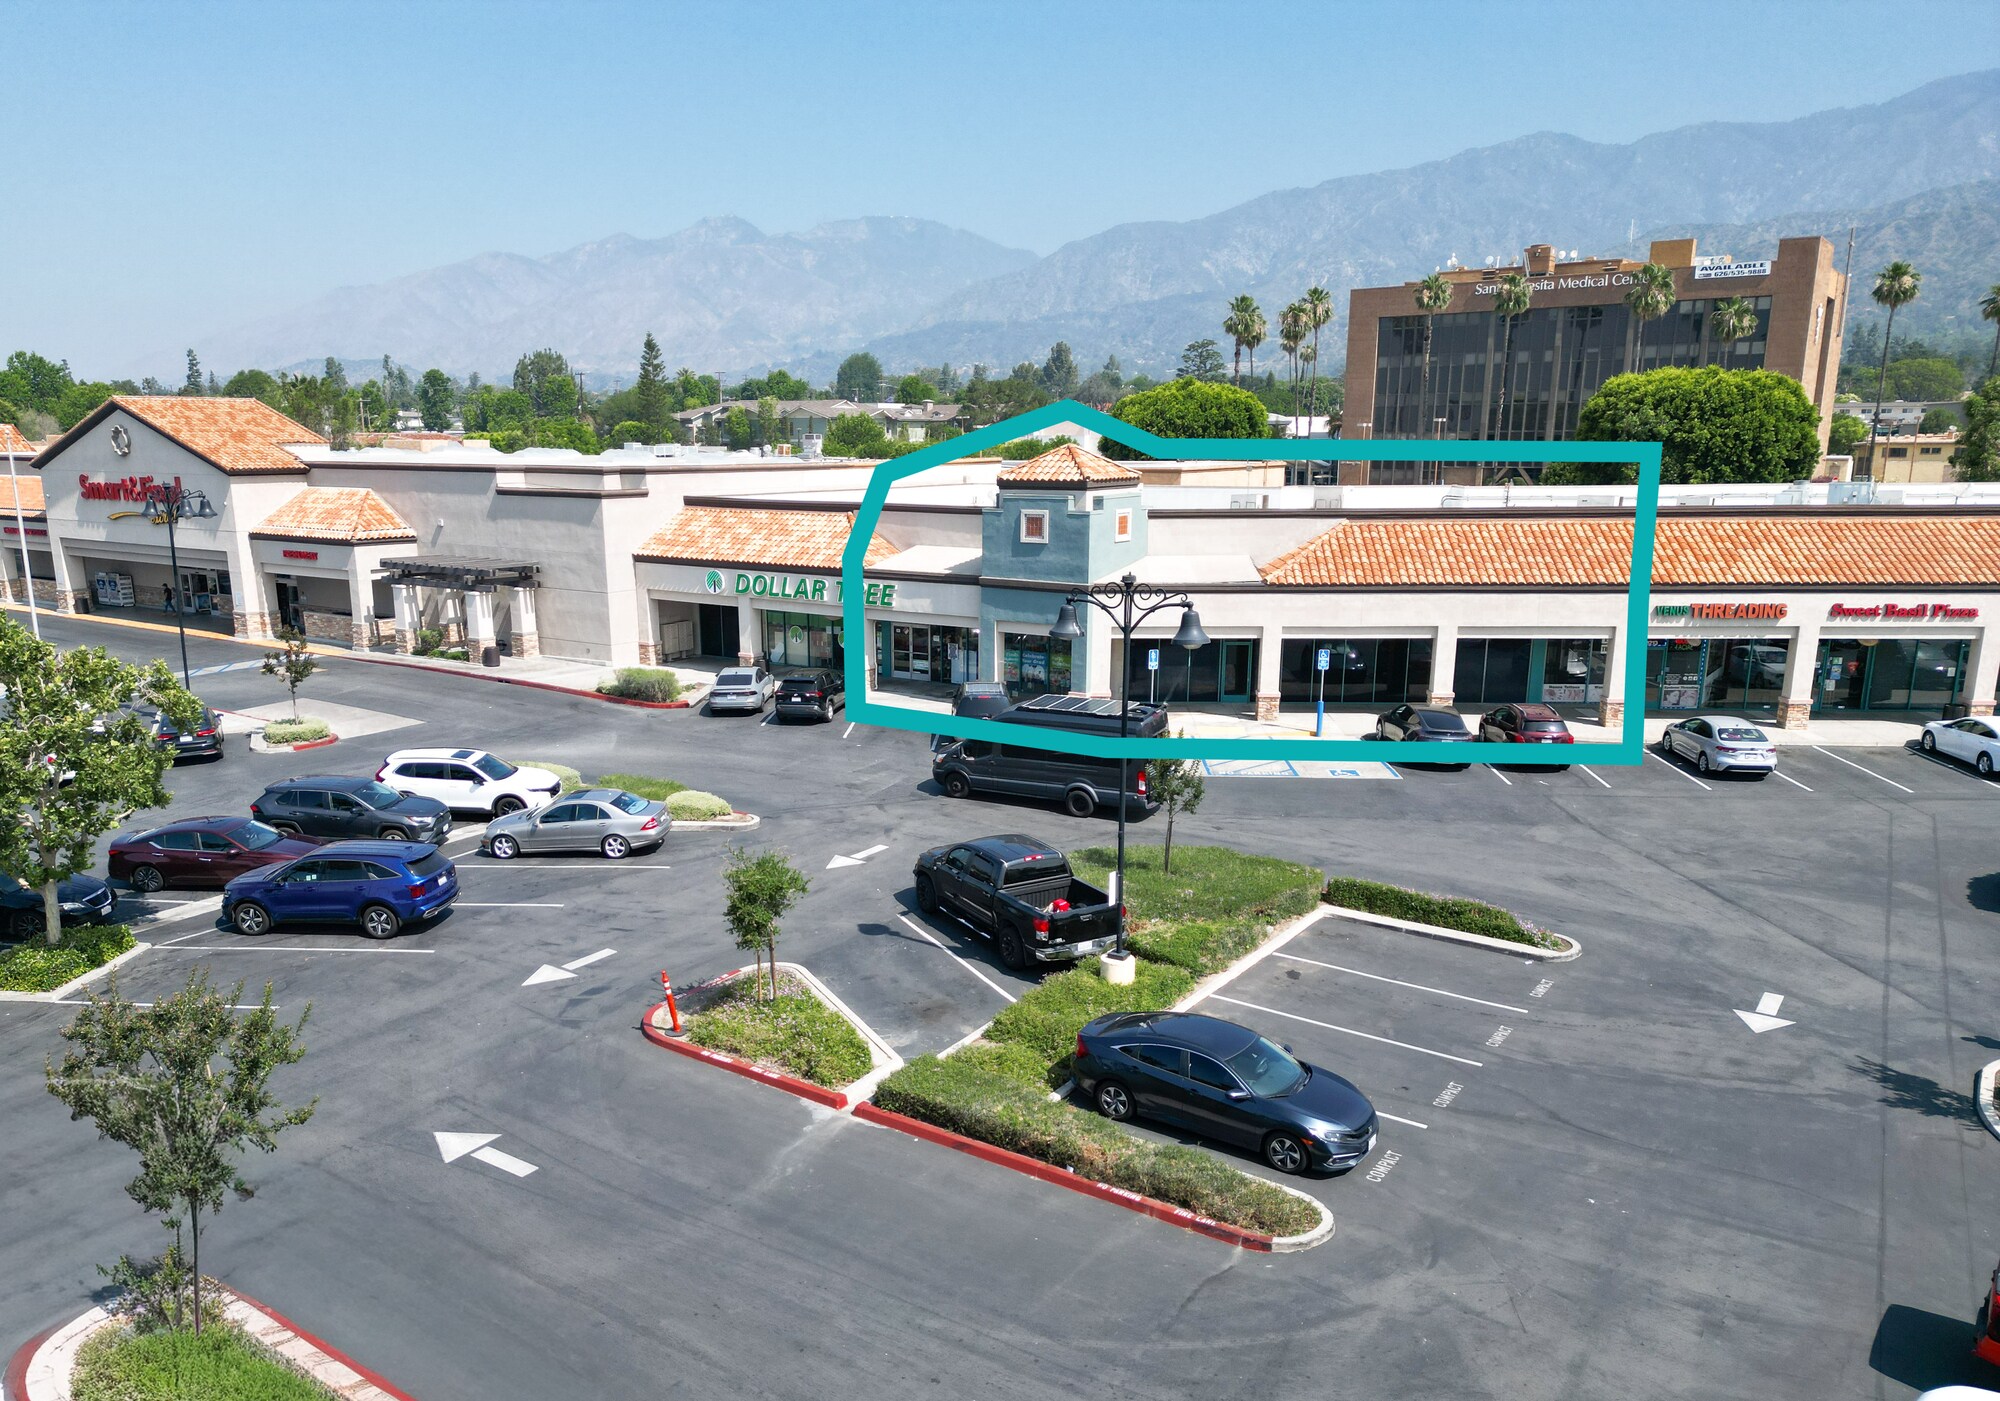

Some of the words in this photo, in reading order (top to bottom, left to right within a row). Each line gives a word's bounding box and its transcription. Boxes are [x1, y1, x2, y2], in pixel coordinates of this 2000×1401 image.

[1700, 262, 1766, 271] AVAILABLE
[1558, 274, 1608, 290] Medical
[735, 573, 828, 602] DOLLAR
[835, 580, 896, 607] TEE
[1656, 605, 1690, 616] VENUS
[1691, 603, 1788, 619] THREADING
[1830, 603, 1882, 617] Sweet
[1884, 603, 1929, 617] Basil
[1931, 603, 1979, 618] Pizza
[1529, 978, 1554, 998] COMPACT
[1485, 1025, 1513, 1047] COMPACT
[1432, 1081, 1464, 1107] COMPACT
[1366, 1150, 1402, 1182] COMPACT
[1096, 1182, 1109, 1190] NO
[1110, 1186, 1142, 1201] PARKING
[1174, 1208, 1195, 1219] FIRE
[1196, 1216, 1217, 1227] LANE
